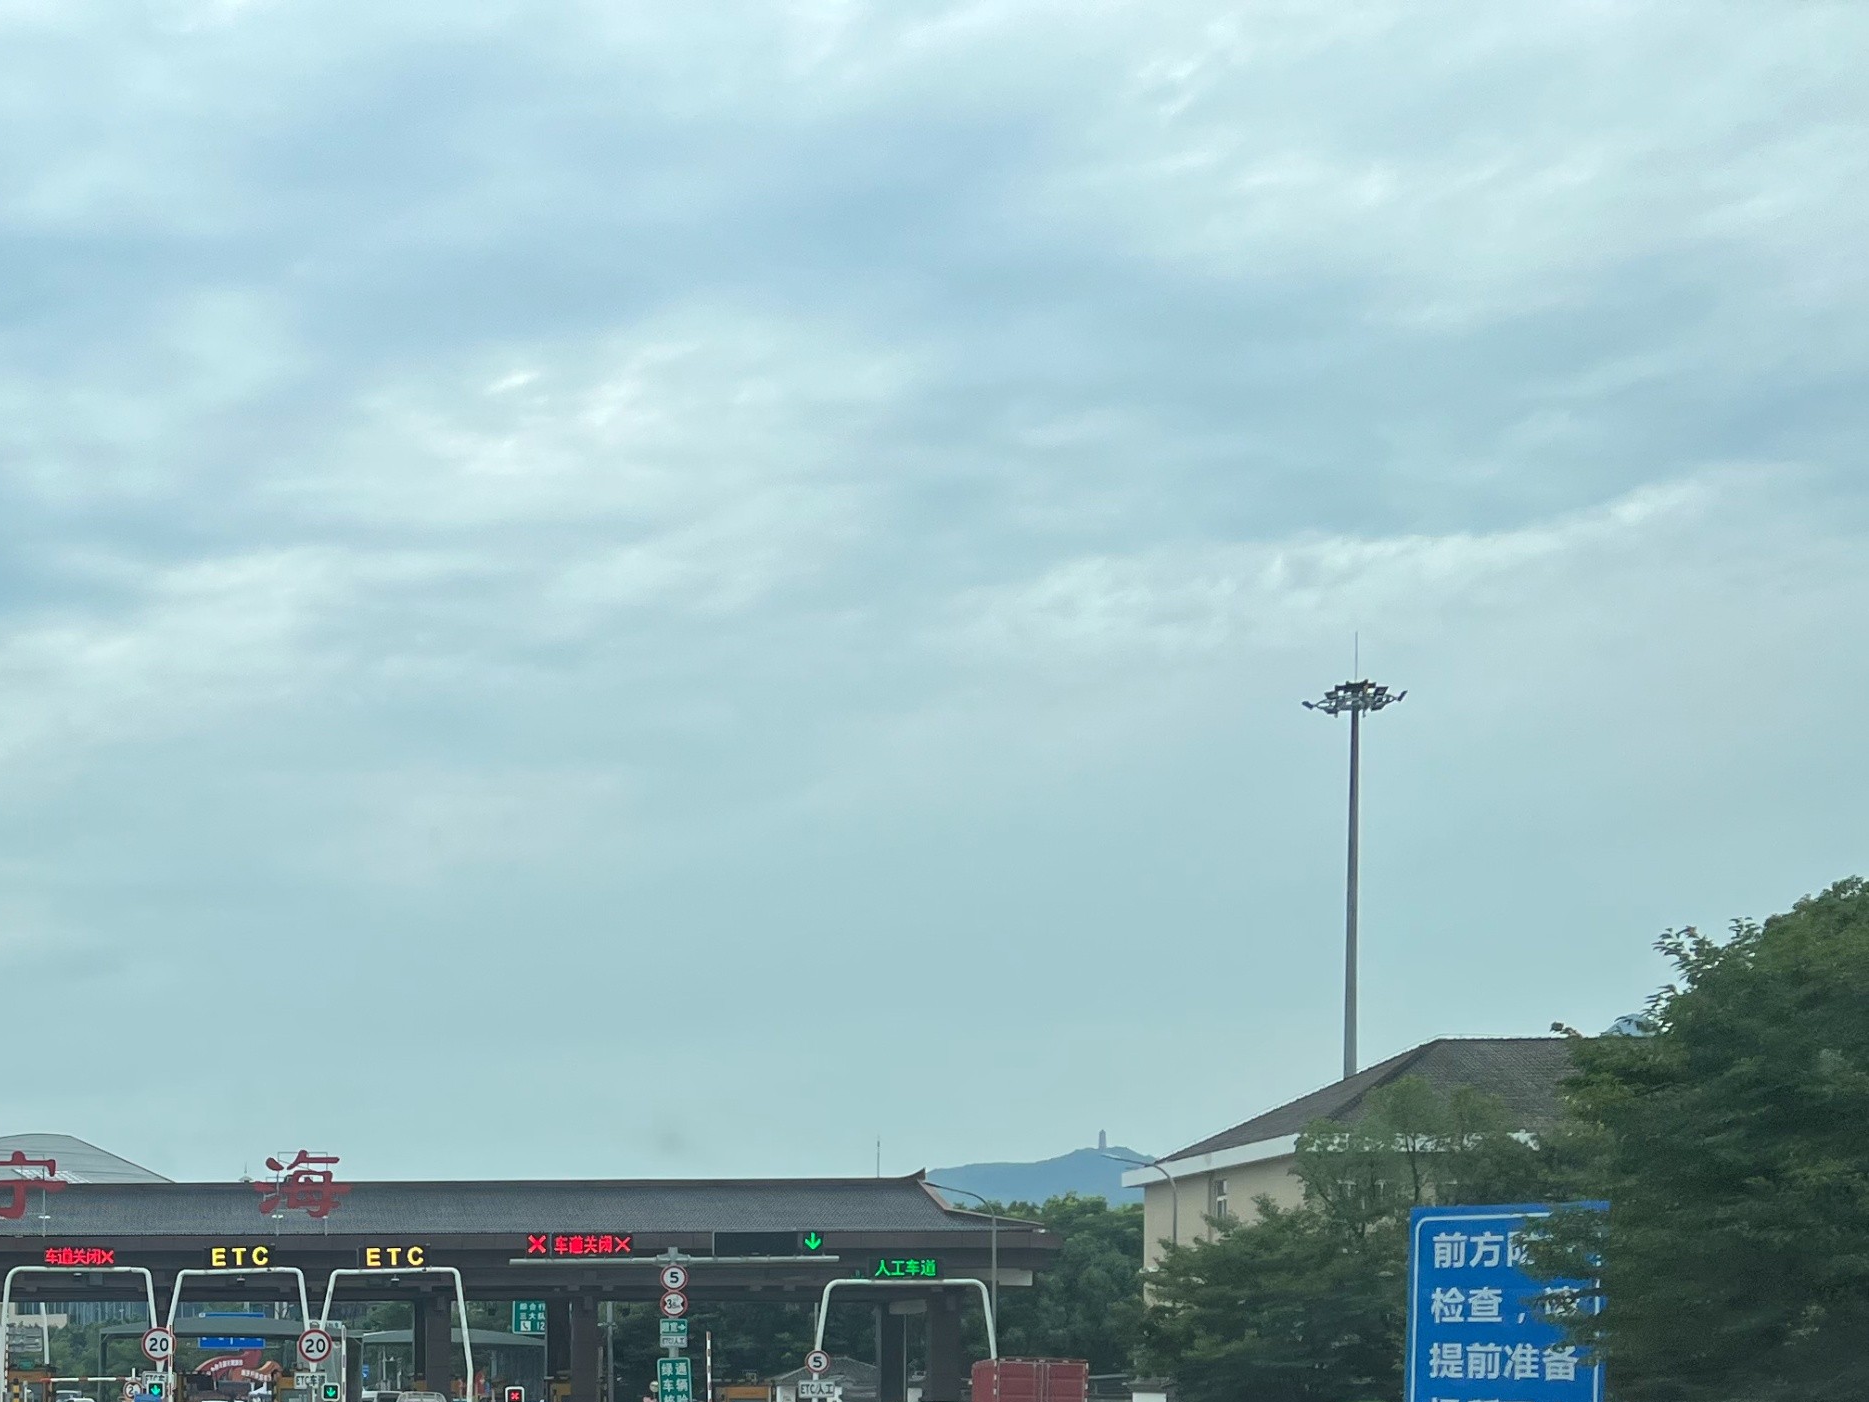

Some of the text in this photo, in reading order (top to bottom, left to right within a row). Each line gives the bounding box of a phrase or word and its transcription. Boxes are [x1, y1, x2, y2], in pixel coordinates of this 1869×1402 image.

[211, 1246, 269, 1267] ETC
[366, 1246, 424, 1267] ETC
[875, 1259, 936, 1277] 人工车道
[670, 1271, 679, 1284] 5
[149, 1337, 169, 1352] 20
[305, 1338, 326, 1354] 20
[813, 1356, 823, 1368] 5
[1428, 1341, 1579, 1382] 提前准备
[800, 1384, 833, 1395] ETC/人工
